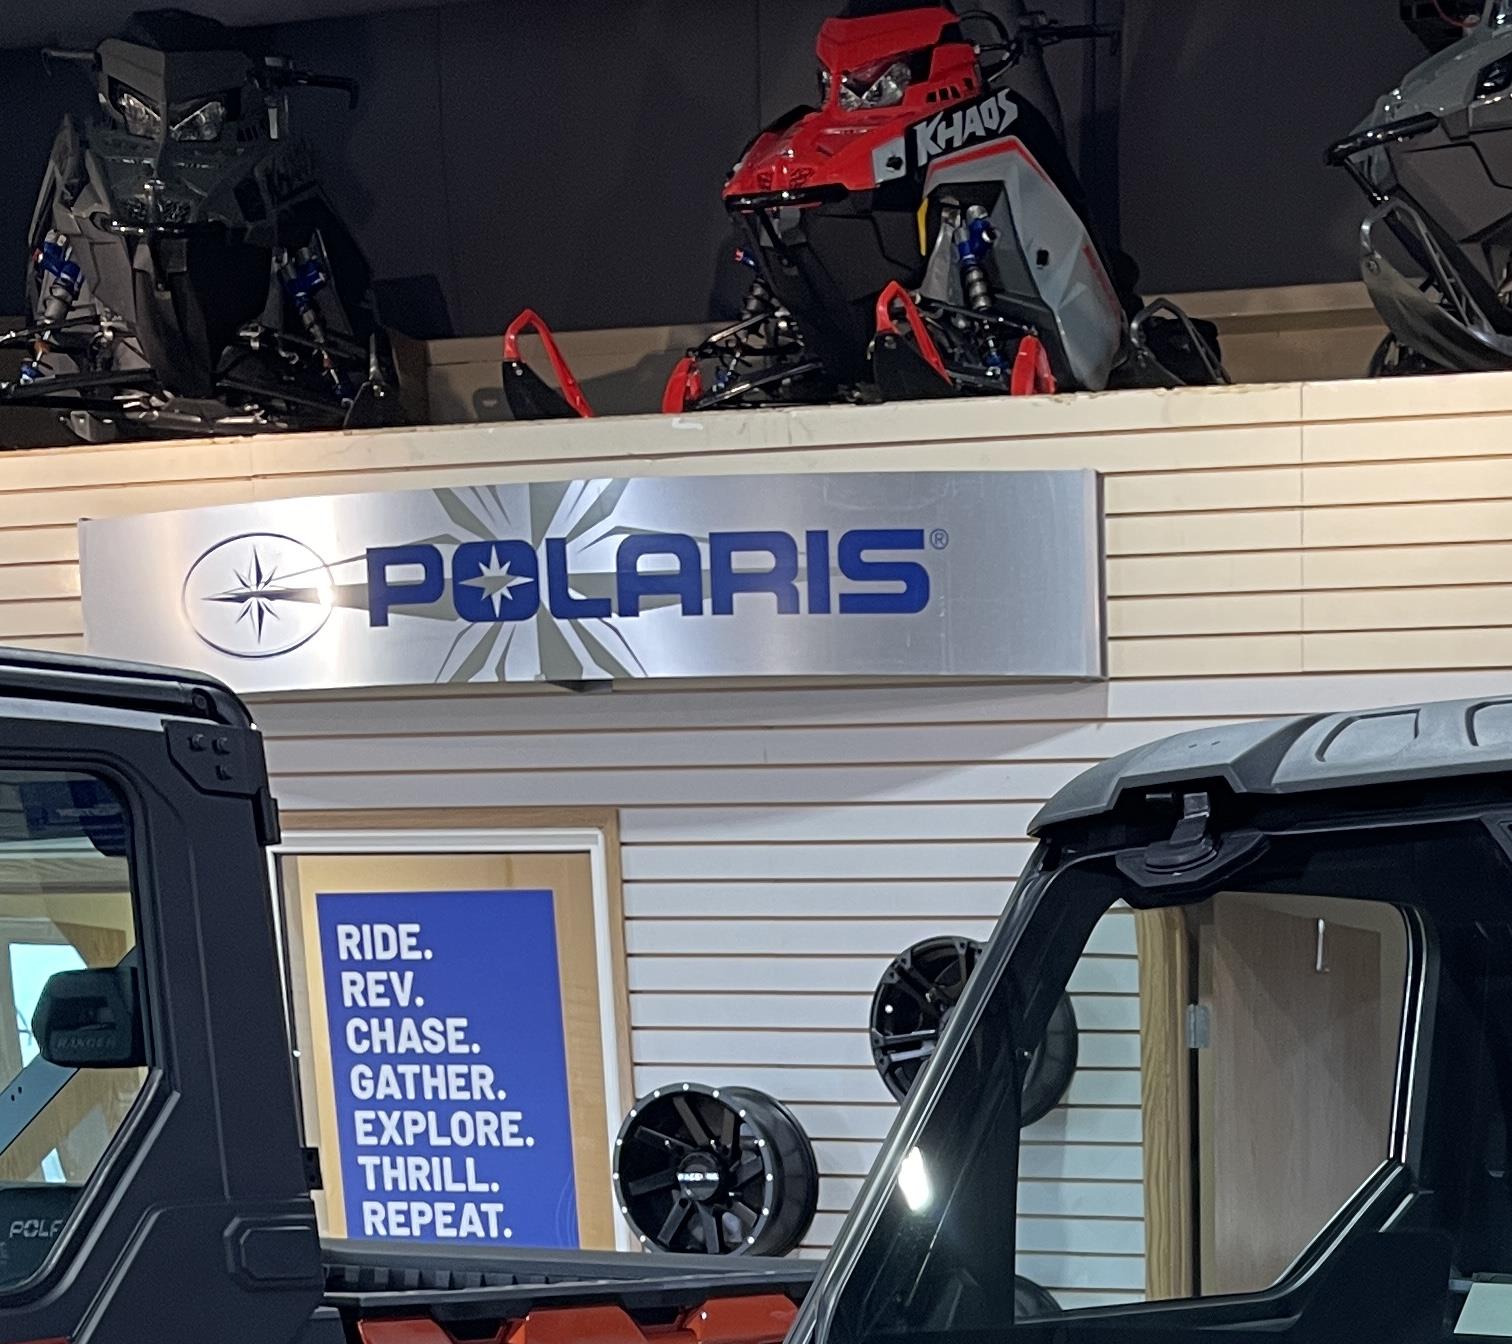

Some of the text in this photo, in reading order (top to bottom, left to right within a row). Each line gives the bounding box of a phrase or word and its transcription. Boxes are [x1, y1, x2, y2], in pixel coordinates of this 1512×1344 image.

[912, 87, 1019, 168] KHAOS
[336, 923, 433, 961] RIDE.
[341, 970, 425, 1008] REV.
[345, 1017, 481, 1055] CHASE.
[349, 1063, 507, 1101] GATHER.
[354, 1110, 535, 1147] EXPLORE.
[356, 1156, 500, 1192] THRILL.
[361, 1200, 513, 1239] REPEAT.
